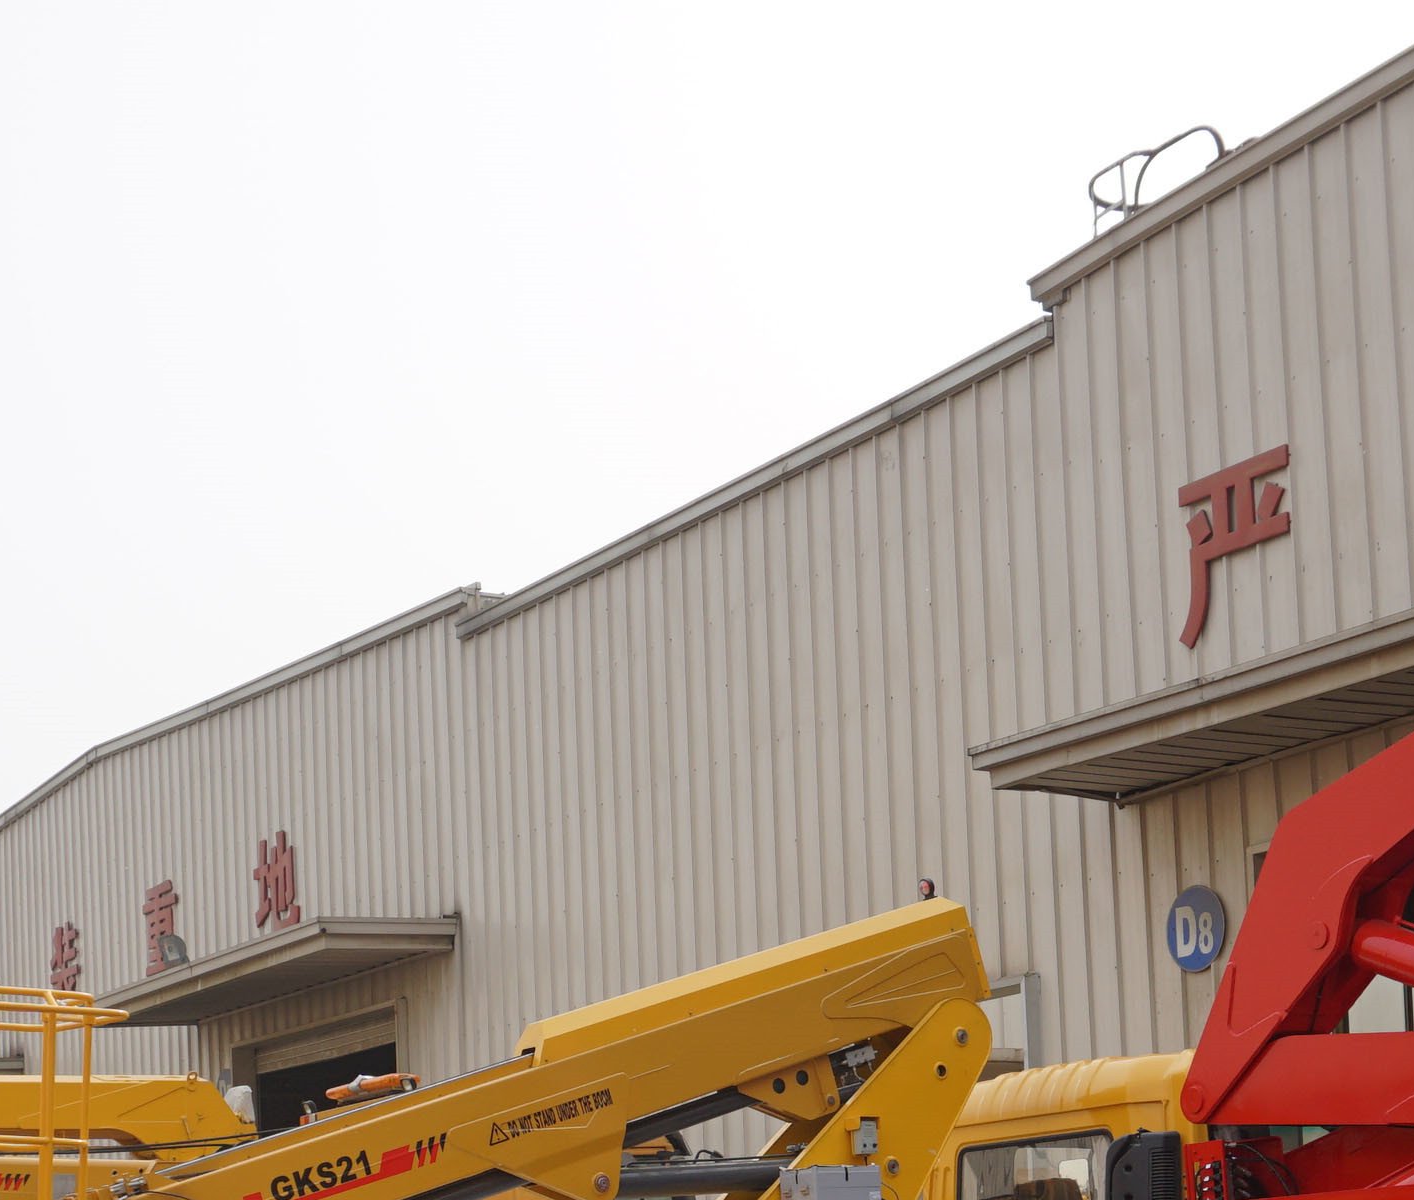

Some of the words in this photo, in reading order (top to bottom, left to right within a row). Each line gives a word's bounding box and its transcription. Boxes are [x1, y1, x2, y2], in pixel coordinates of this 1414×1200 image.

[1175, 905, 1214, 958] D8
[507, 1120, 520, 1138] DO
[519, 1116, 534, 1134] NOT
[534, 1107, 556, 1129] STAND
[556, 1100, 580, 1122] UNDER
[578, 1095, 593, 1114] THE
[592, 1088, 614, 1110] BOOM
